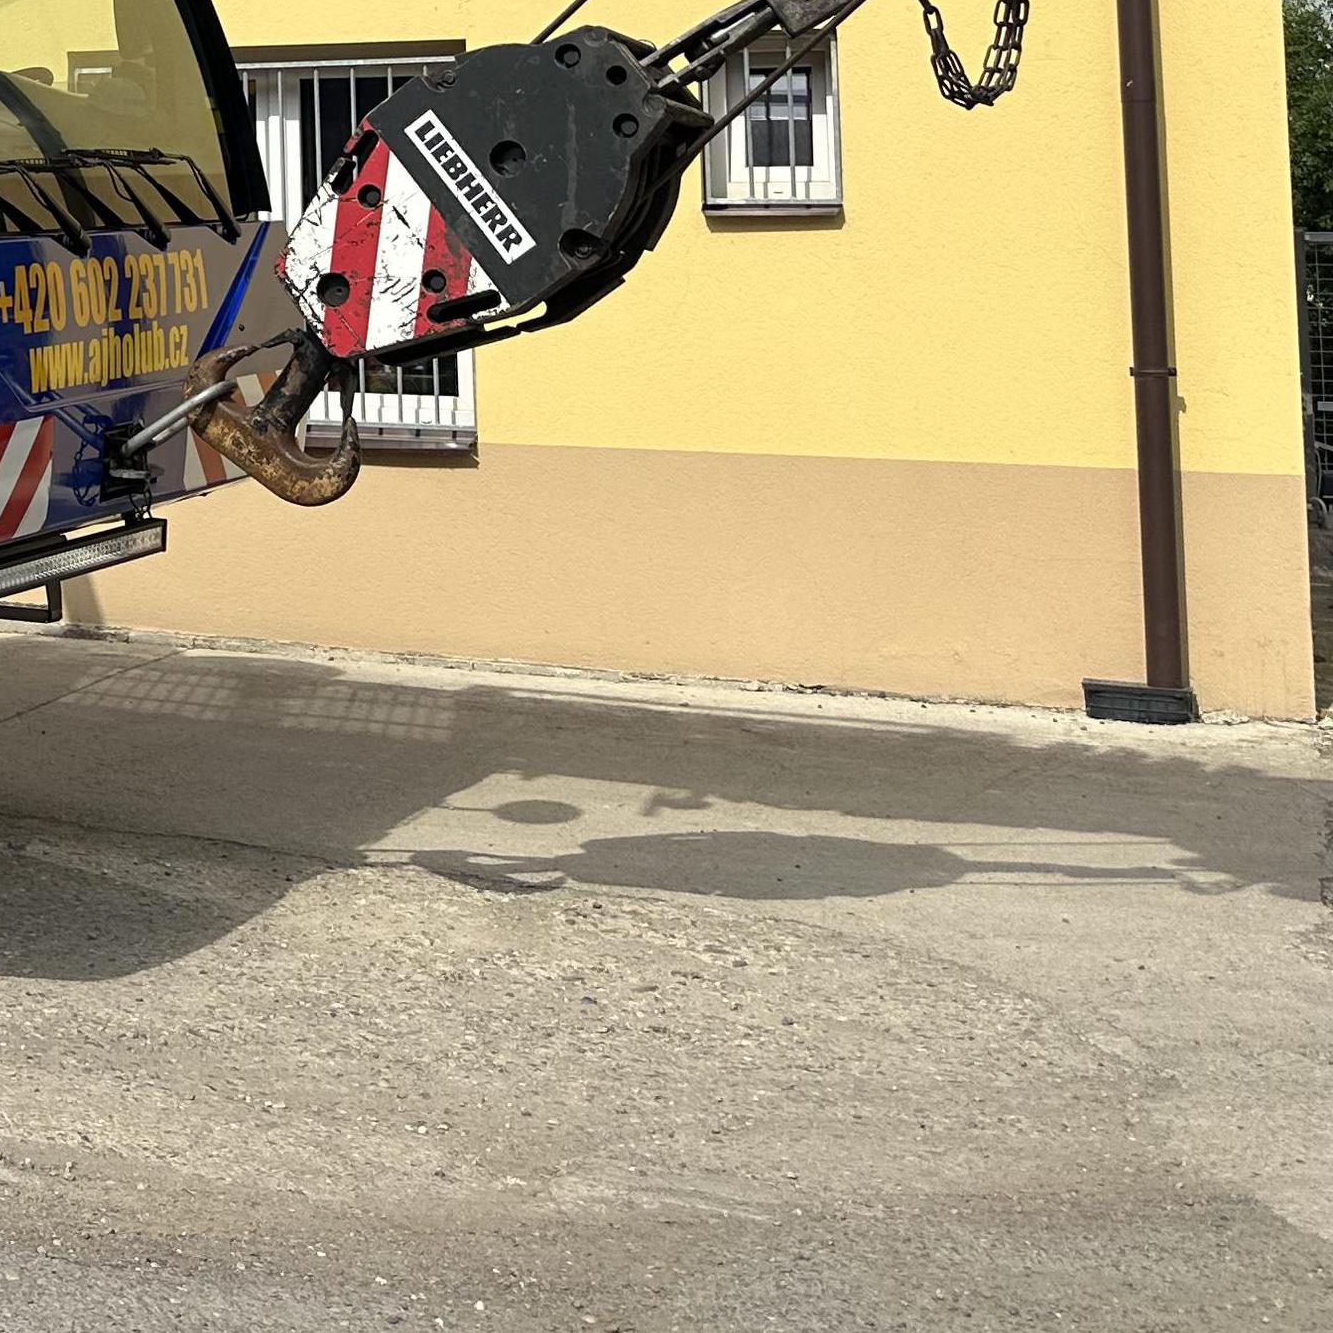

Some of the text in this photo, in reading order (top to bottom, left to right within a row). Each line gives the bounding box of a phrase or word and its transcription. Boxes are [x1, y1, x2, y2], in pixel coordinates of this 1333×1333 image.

[414, 120, 523, 253] LIEBHERR
[69, 256, 123, 328] 602
[29, 321, 189, 394] www.ajholub.cz
